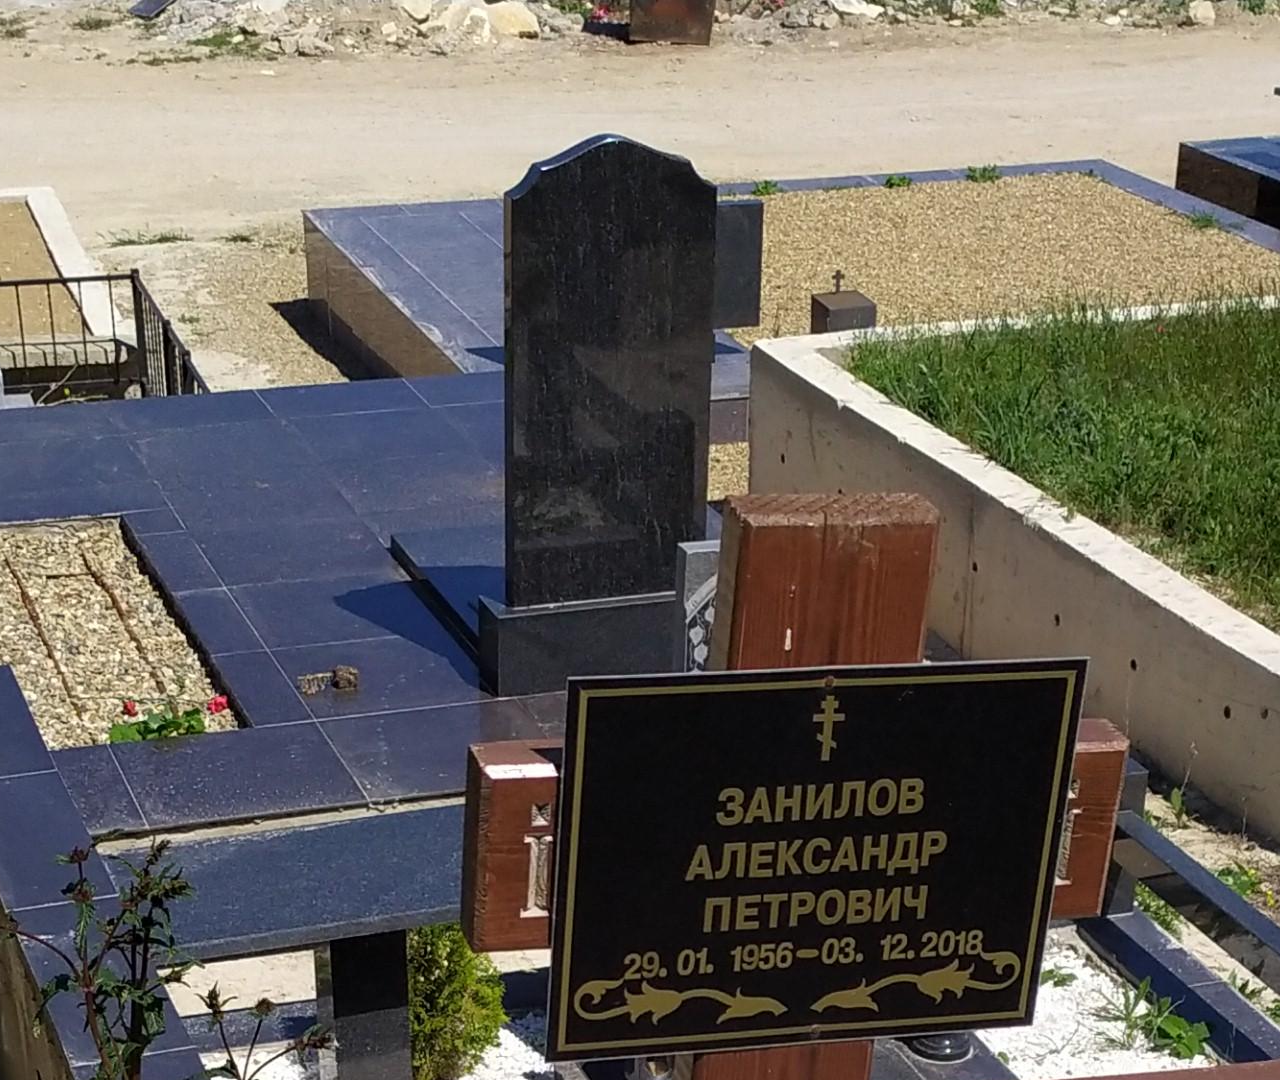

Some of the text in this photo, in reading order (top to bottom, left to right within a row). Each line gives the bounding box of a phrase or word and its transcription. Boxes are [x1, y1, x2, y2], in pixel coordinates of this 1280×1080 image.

[716, 778, 924, 826] ЗАНИЛОВ
[685, 830, 948, 881] АЛЕКСАНДР
[703, 885, 929, 933] ПЕТРОВИЧ
